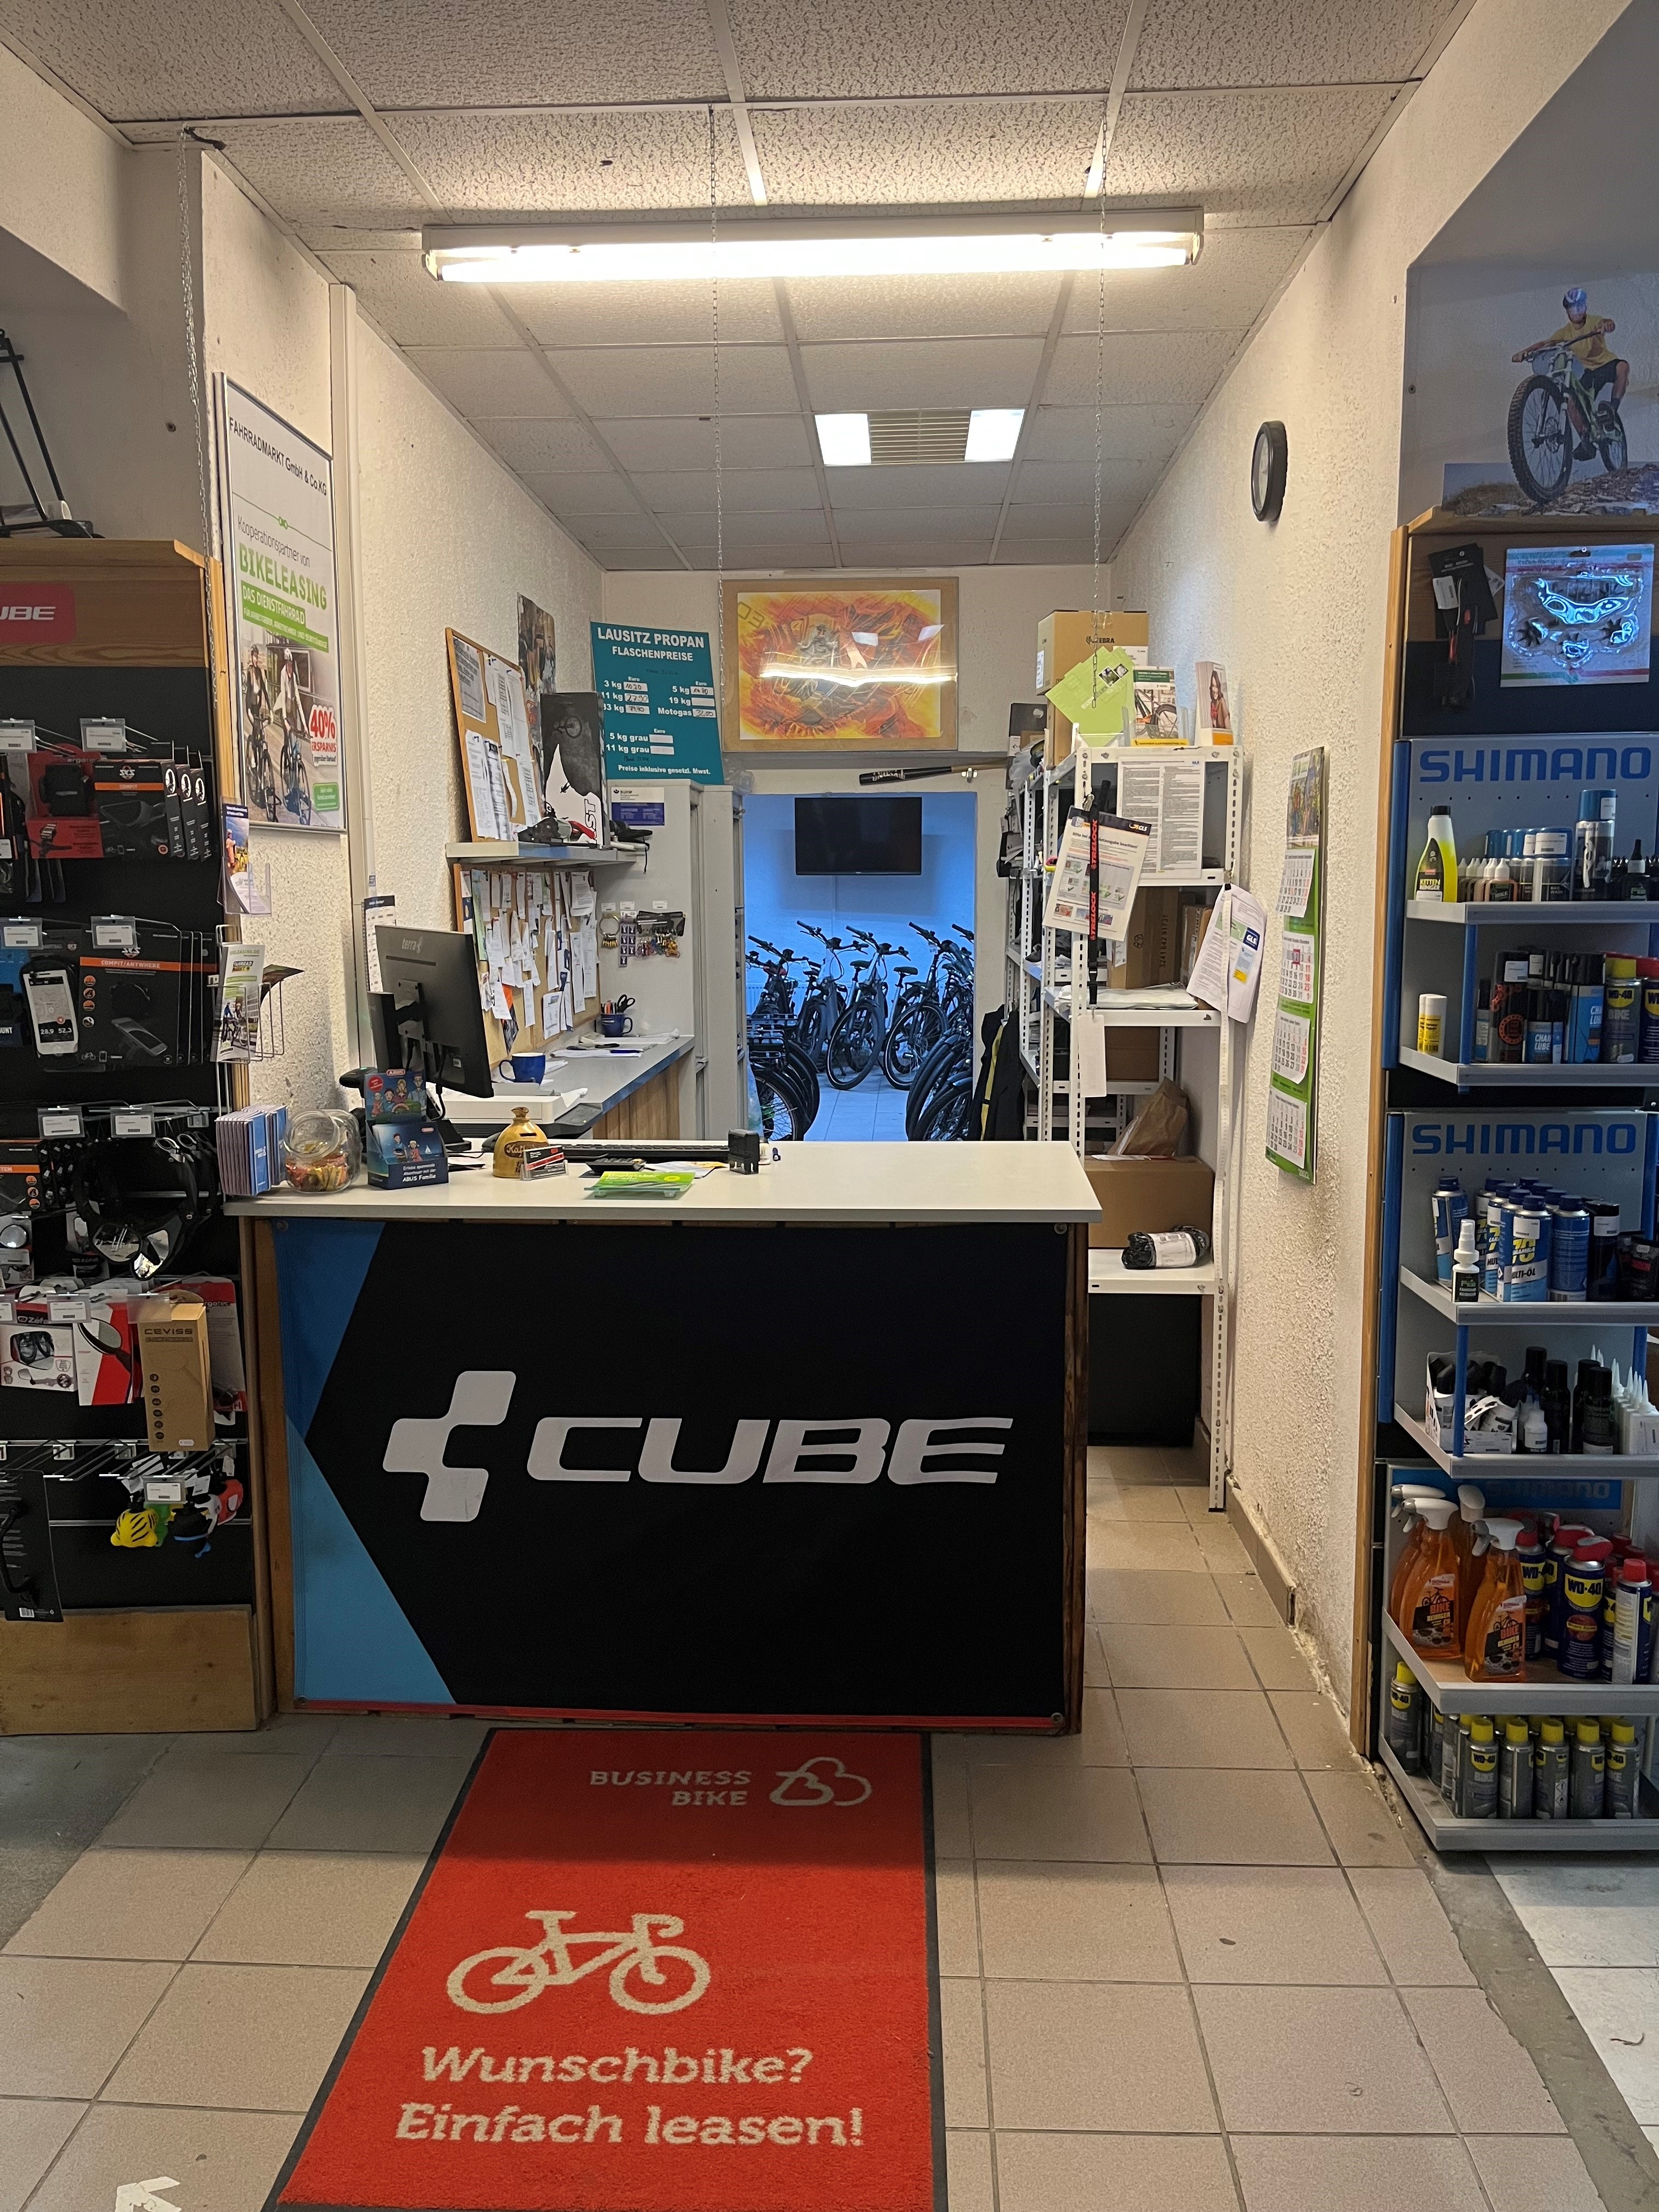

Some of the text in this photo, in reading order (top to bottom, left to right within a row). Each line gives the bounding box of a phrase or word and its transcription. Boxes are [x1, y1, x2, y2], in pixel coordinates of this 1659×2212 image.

[229, 417, 284, 467] FAHRRADMARKT
[285, 458, 303, 480] GmbH
[304, 470, 309, 483] &
[238, 515, 311, 568] Kooperationspartner von
[239, 542, 326, 610] BIKELEASING
[242, 585, 256, 603] DAS
[257, 591, 305, 625] DIENSTFAHRRAD
[597, 627, 704, 648] LAUSITZ PROPAN
[612, 646, 693, 661] FLASCHENPREISE
[612, 681, 622, 690] kg
[680, 686, 690, 695] kg
[613, 692, 623, 701] kg
[681, 698, 691, 706] kg
[614, 704, 624, 713] kg
[658, 707, 692, 716] Motogas
[311, 709, 336, 739] 40%
[617, 733, 627, 742] kg
[618, 745, 628, 753] kg
[1419, 747, 1651, 783] SHIMANO
[402, 938, 416, 951] terra
[101, 960, 160, 968] COMPIT/ANYWHERE
[1412, 1124, 1637, 1155] SHIMANO
[527, 1417, 1013, 1485] CUBE
[1568, 1578, 1602, 1595] WD-40
[1430, 1602, 1450, 1615] BIKE
[590, 1770, 752, 1786] BUSINESS
[672, 1790, 749, 1805] BIKE
[421, 2046, 812, 2084] Wunschbike?
[396, 2102, 864, 2147] Einfach leasen!
